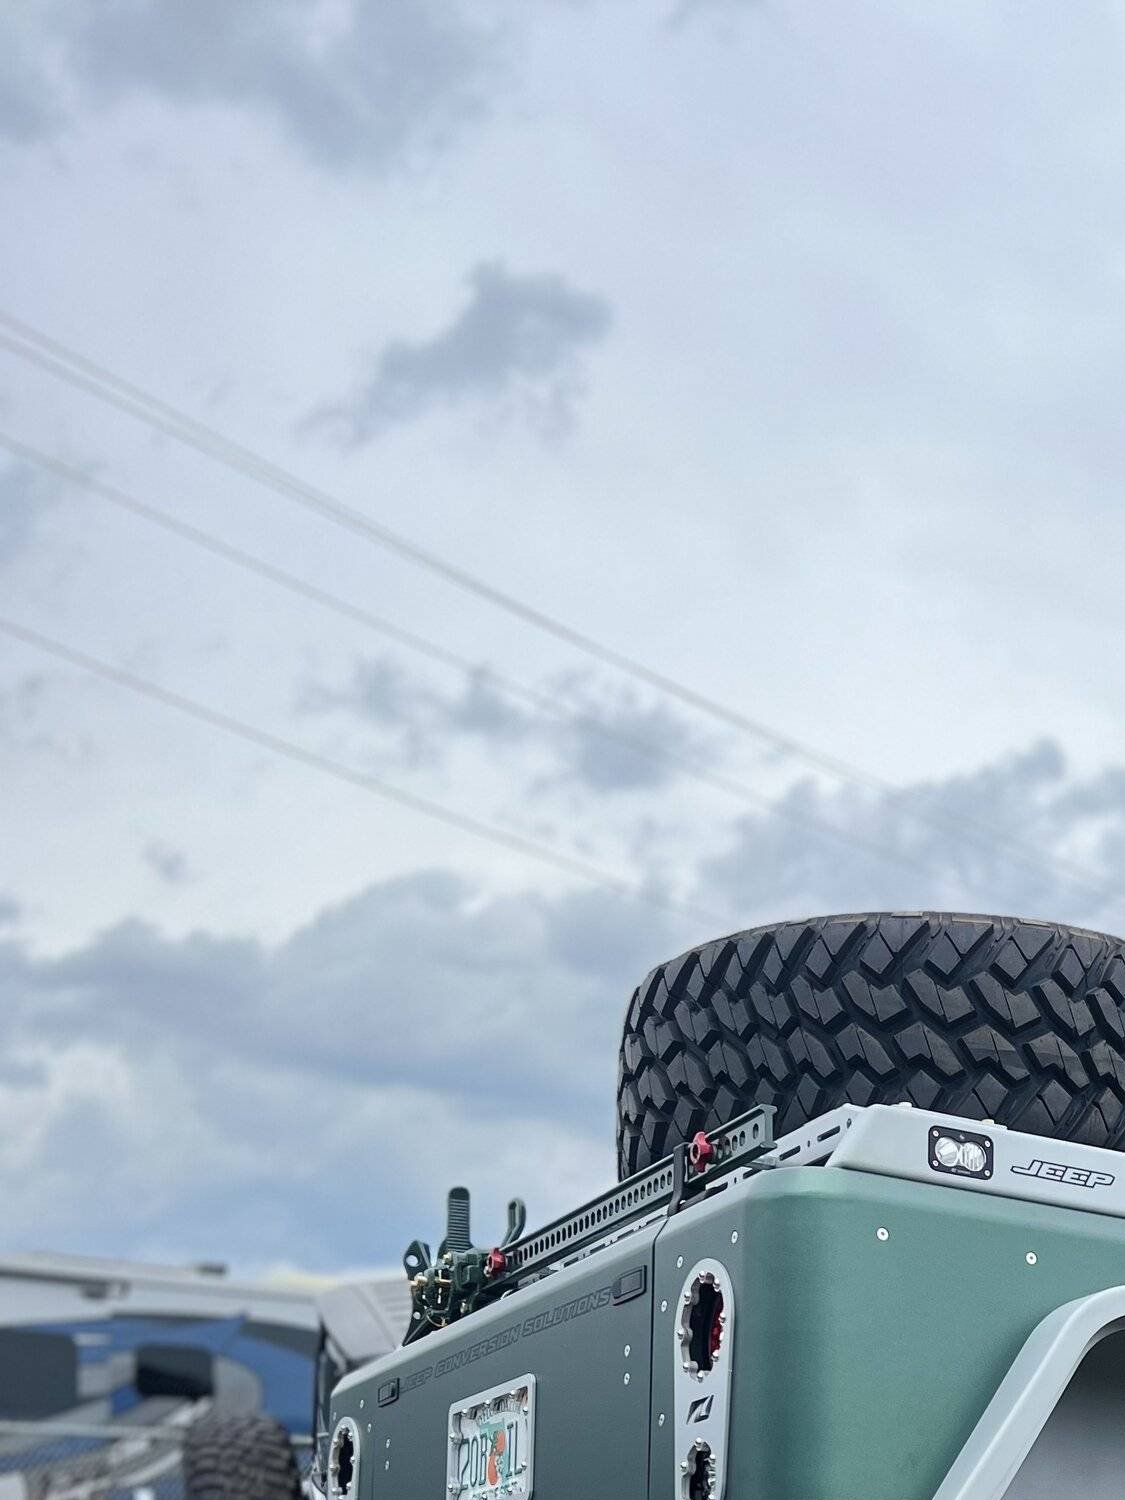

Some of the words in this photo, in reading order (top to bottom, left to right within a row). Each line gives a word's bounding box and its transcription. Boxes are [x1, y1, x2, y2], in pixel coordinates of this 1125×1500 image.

[1010, 1159, 1115, 1189] JEEP
[434, 1323, 521, 1378] CONVERSION
[522, 1286, 612, 1337] SOLUTIONS
